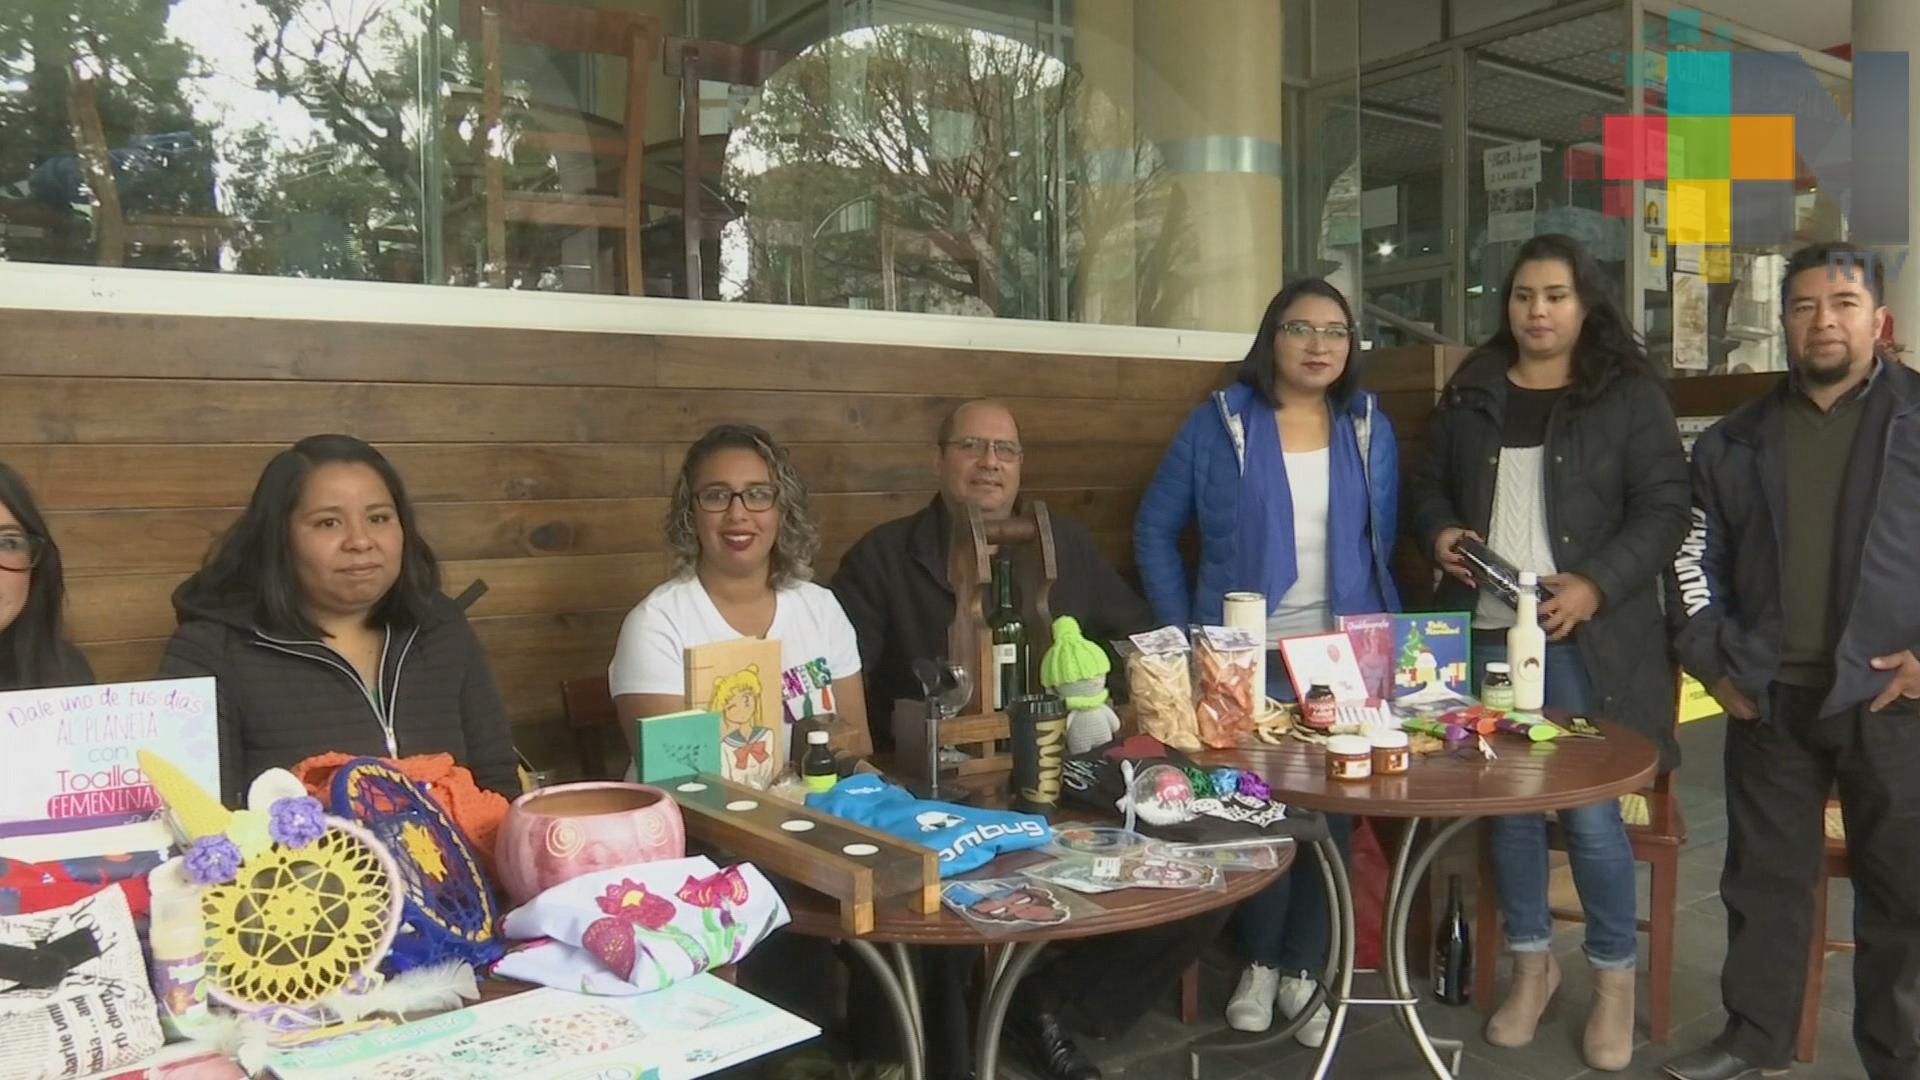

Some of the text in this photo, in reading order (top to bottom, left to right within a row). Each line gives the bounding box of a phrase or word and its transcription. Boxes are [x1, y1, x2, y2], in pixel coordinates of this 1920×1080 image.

[8, 698, 54, 728] Dale
[60, 695, 93, 712] uno
[100, 687, 120, 707] de
[129, 687, 157, 706] tus
[57, 711, 158, 746] AL PLANETA
[88, 745, 129, 763] con
[69, 994, 90, 1017] and
